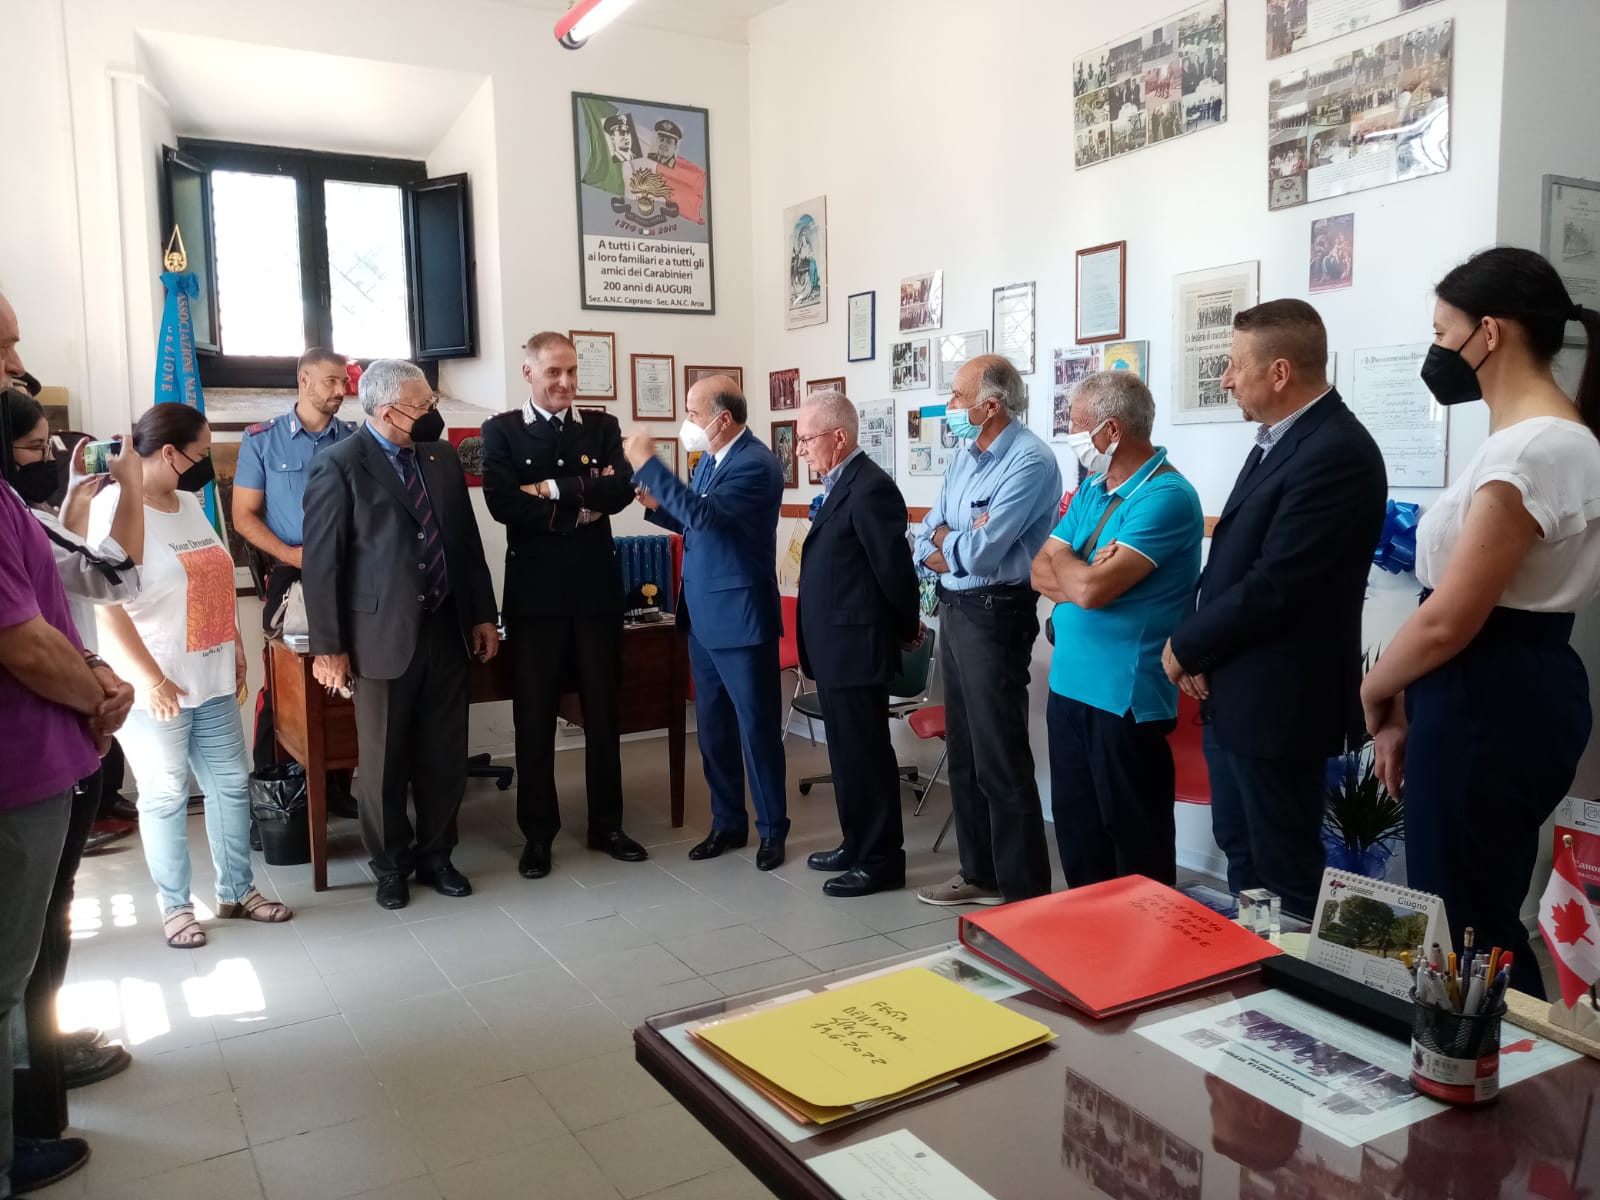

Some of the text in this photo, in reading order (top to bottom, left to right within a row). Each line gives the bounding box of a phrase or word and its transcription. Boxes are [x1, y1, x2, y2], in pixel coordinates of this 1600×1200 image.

[598, 240, 606, 249] A
[608, 241, 631, 251] tutti
[637, 242, 695, 256] Carabinieri,
[587, 252, 597, 261] ai
[598, 252, 617, 263] loro
[618, 253, 657, 265] familiari
[672, 258, 692, 268] tutti
[693, 258, 705, 270] gli
[600, 266, 693, 280] amici dei Carabinieri
[603, 281, 692, 295] 200 anni di AUGURI
[177, 292, 194, 374] ASSOCIAZIONE
[1397, 896, 1428, 911] Giugno
